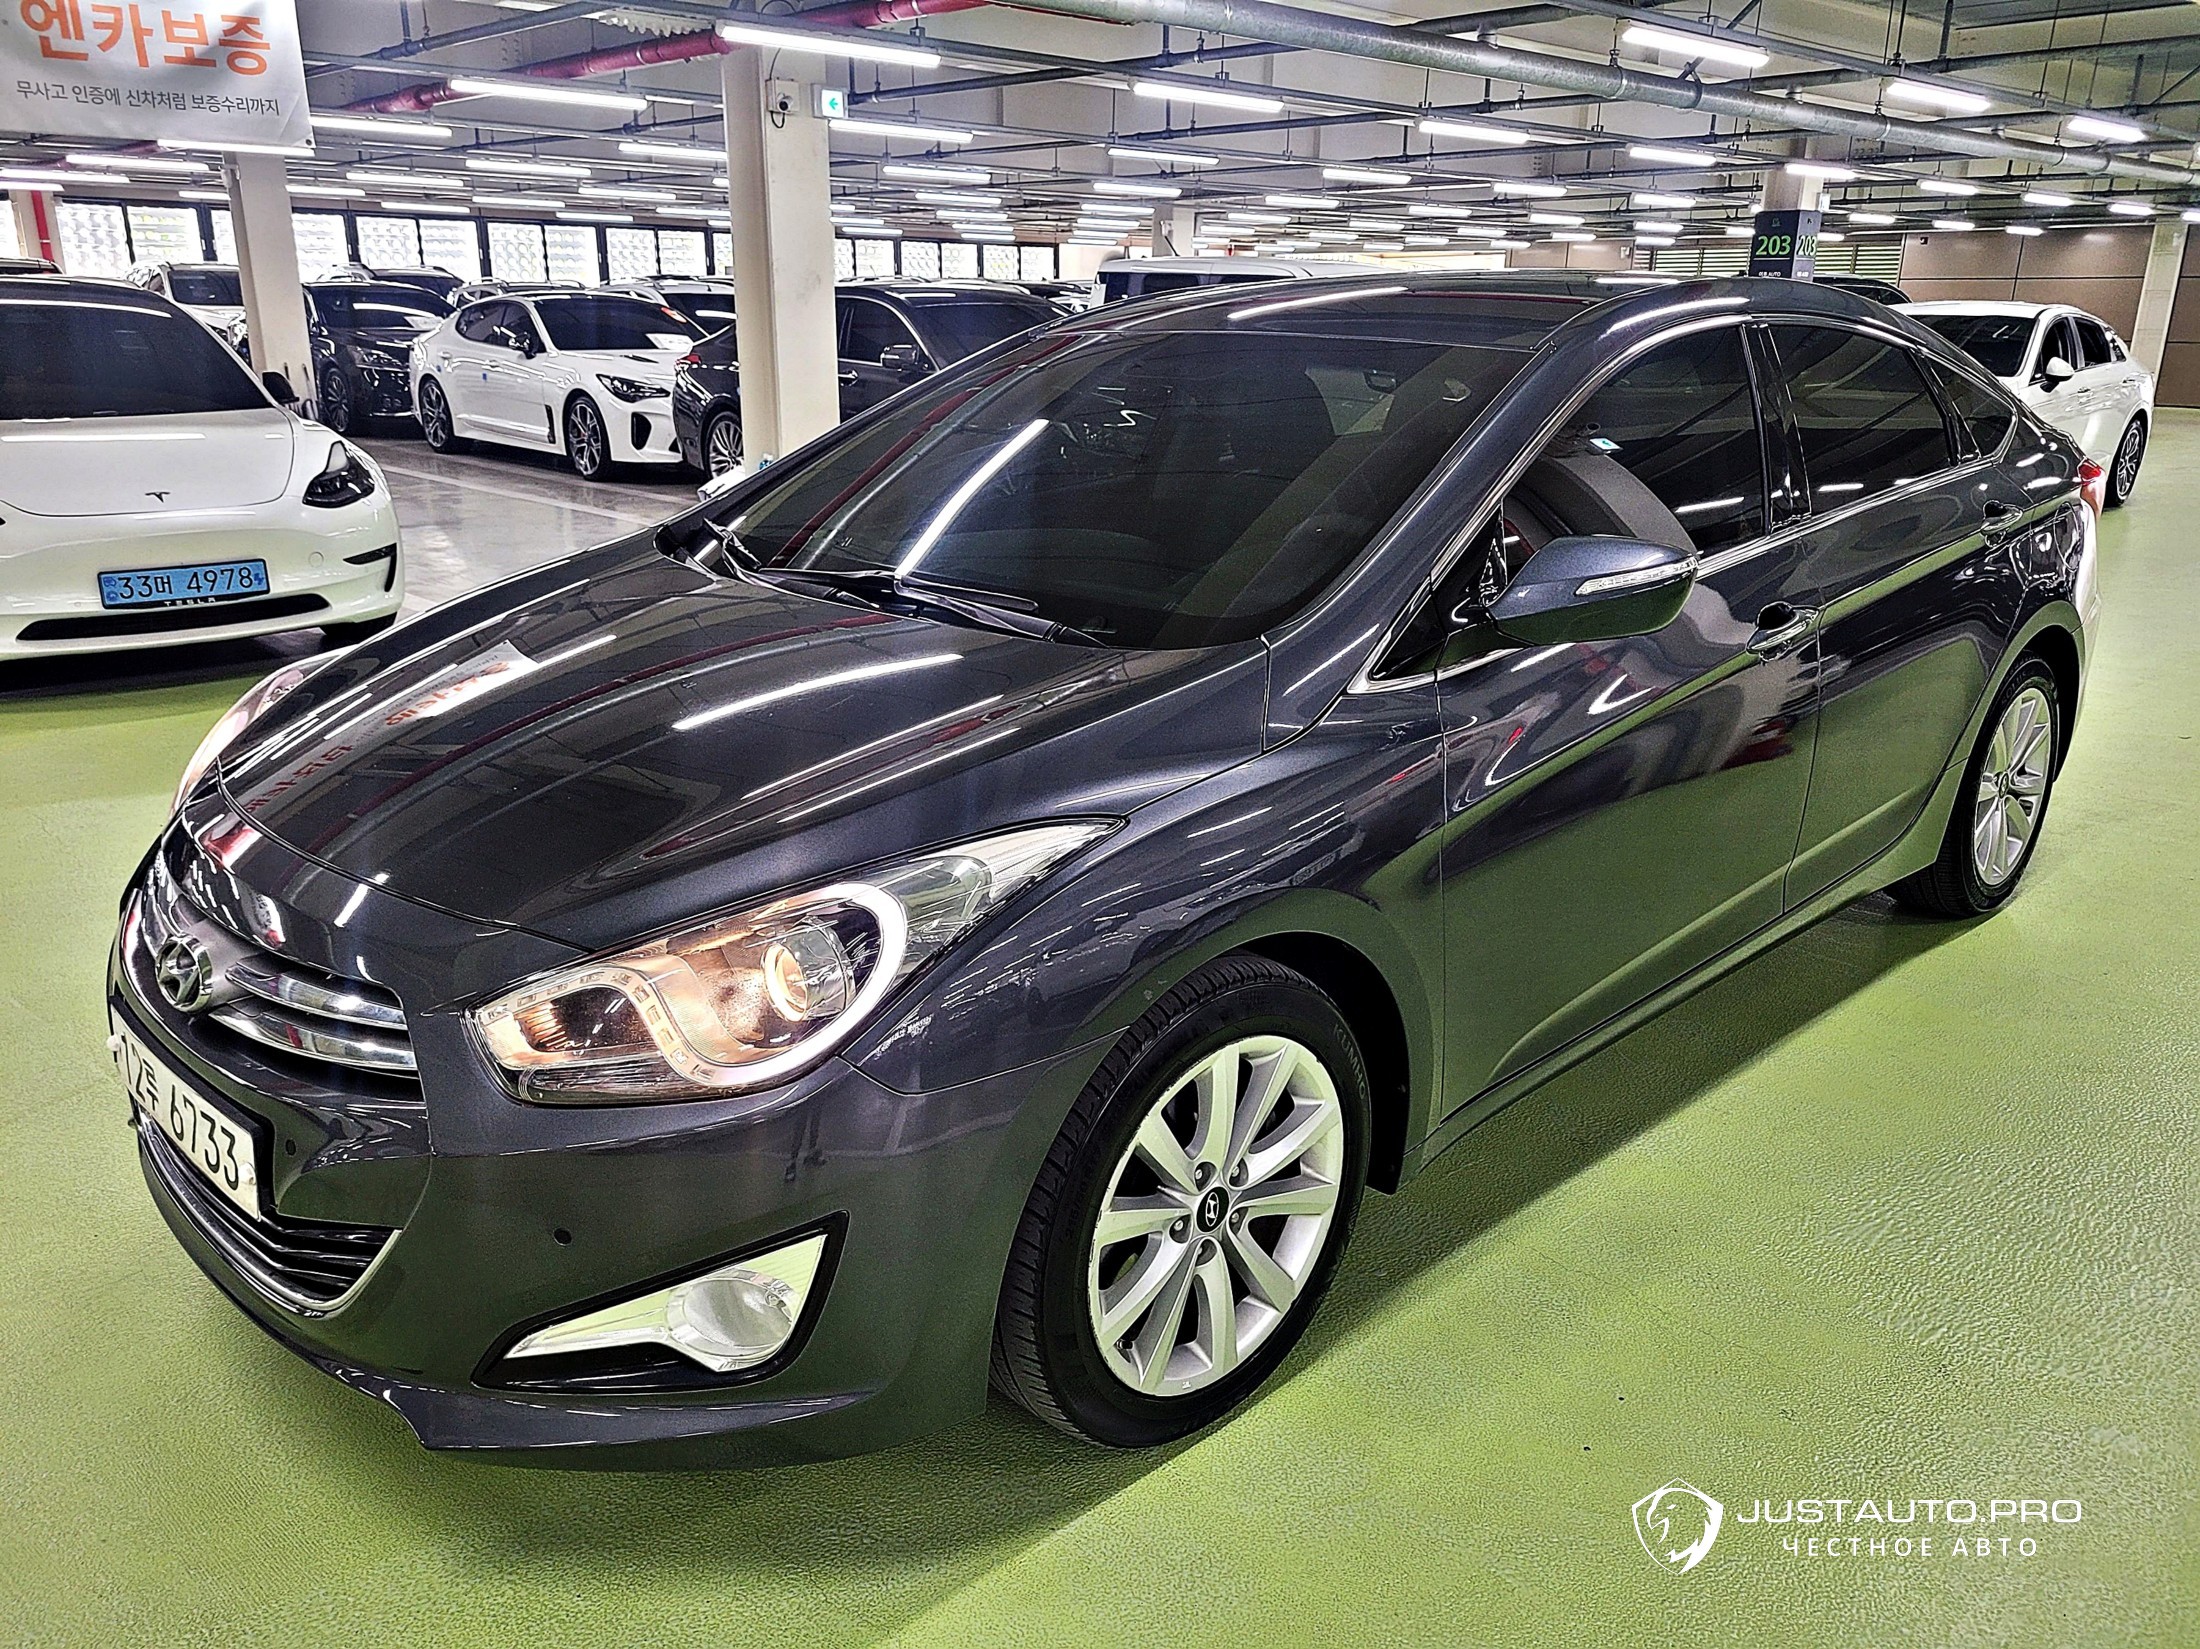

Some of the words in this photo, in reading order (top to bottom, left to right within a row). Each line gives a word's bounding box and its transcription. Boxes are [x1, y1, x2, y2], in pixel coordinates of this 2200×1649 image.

[20, 0, 271, 75] 엔카보증
[17, 80, 68, 100] 무사고
[72, 85, 121, 105] 인증에
[126, 90, 187, 111] 신차처럼
[191, 94, 279, 116] 보증수리까지
[1755, 234, 1792, 256] 203
[1797, 234, 1817, 257] 203
[118, 575, 173, 599] 33머
[187, 567, 253, 593] 4978
[1333, 1023, 1365, 1100] KUMHO
[170, 1084, 239, 1191] 6733
